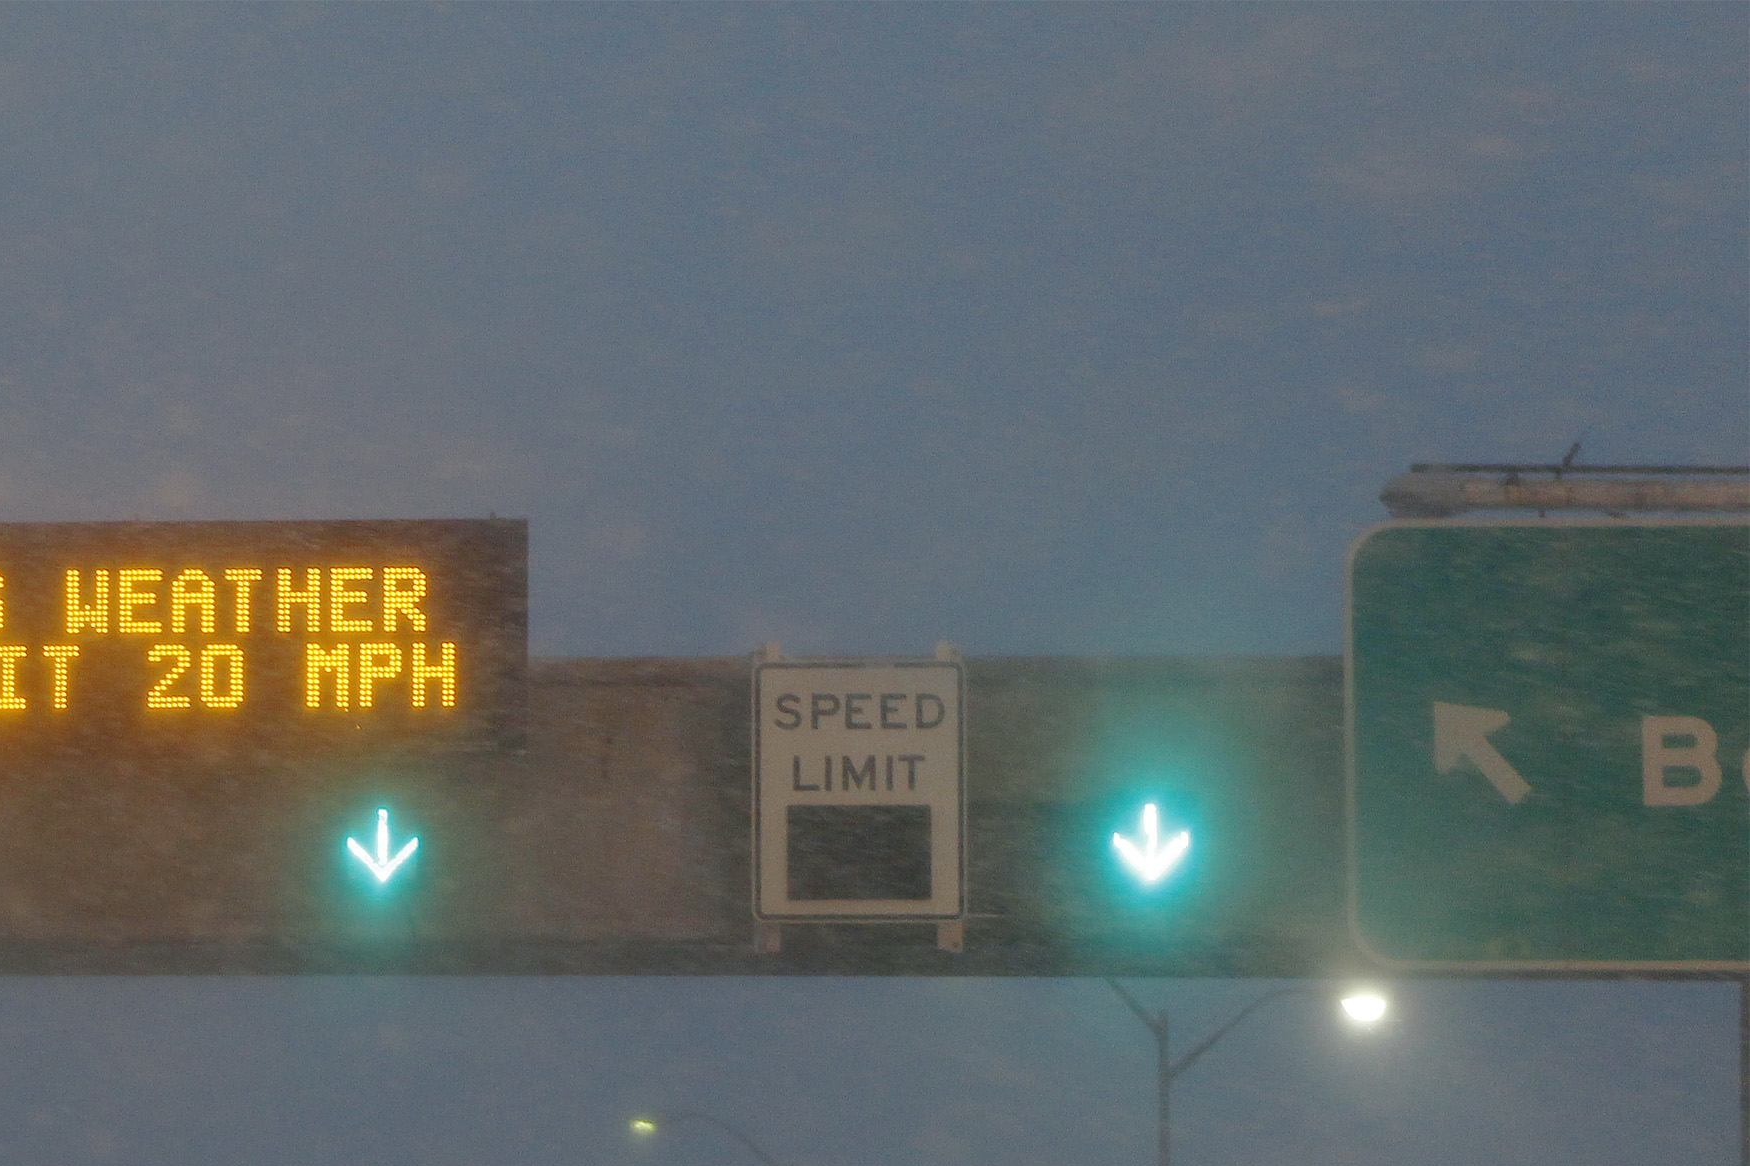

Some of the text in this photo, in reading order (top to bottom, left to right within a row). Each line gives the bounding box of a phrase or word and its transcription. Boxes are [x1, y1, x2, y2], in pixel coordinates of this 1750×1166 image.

[64, 566, 428, 636] WEATHER
[146, 643, 245, 710] 20
[304, 640, 458, 709] MPH
[774, 692, 946, 730] SPEED
[792, 754, 925, 792] LIMIT
